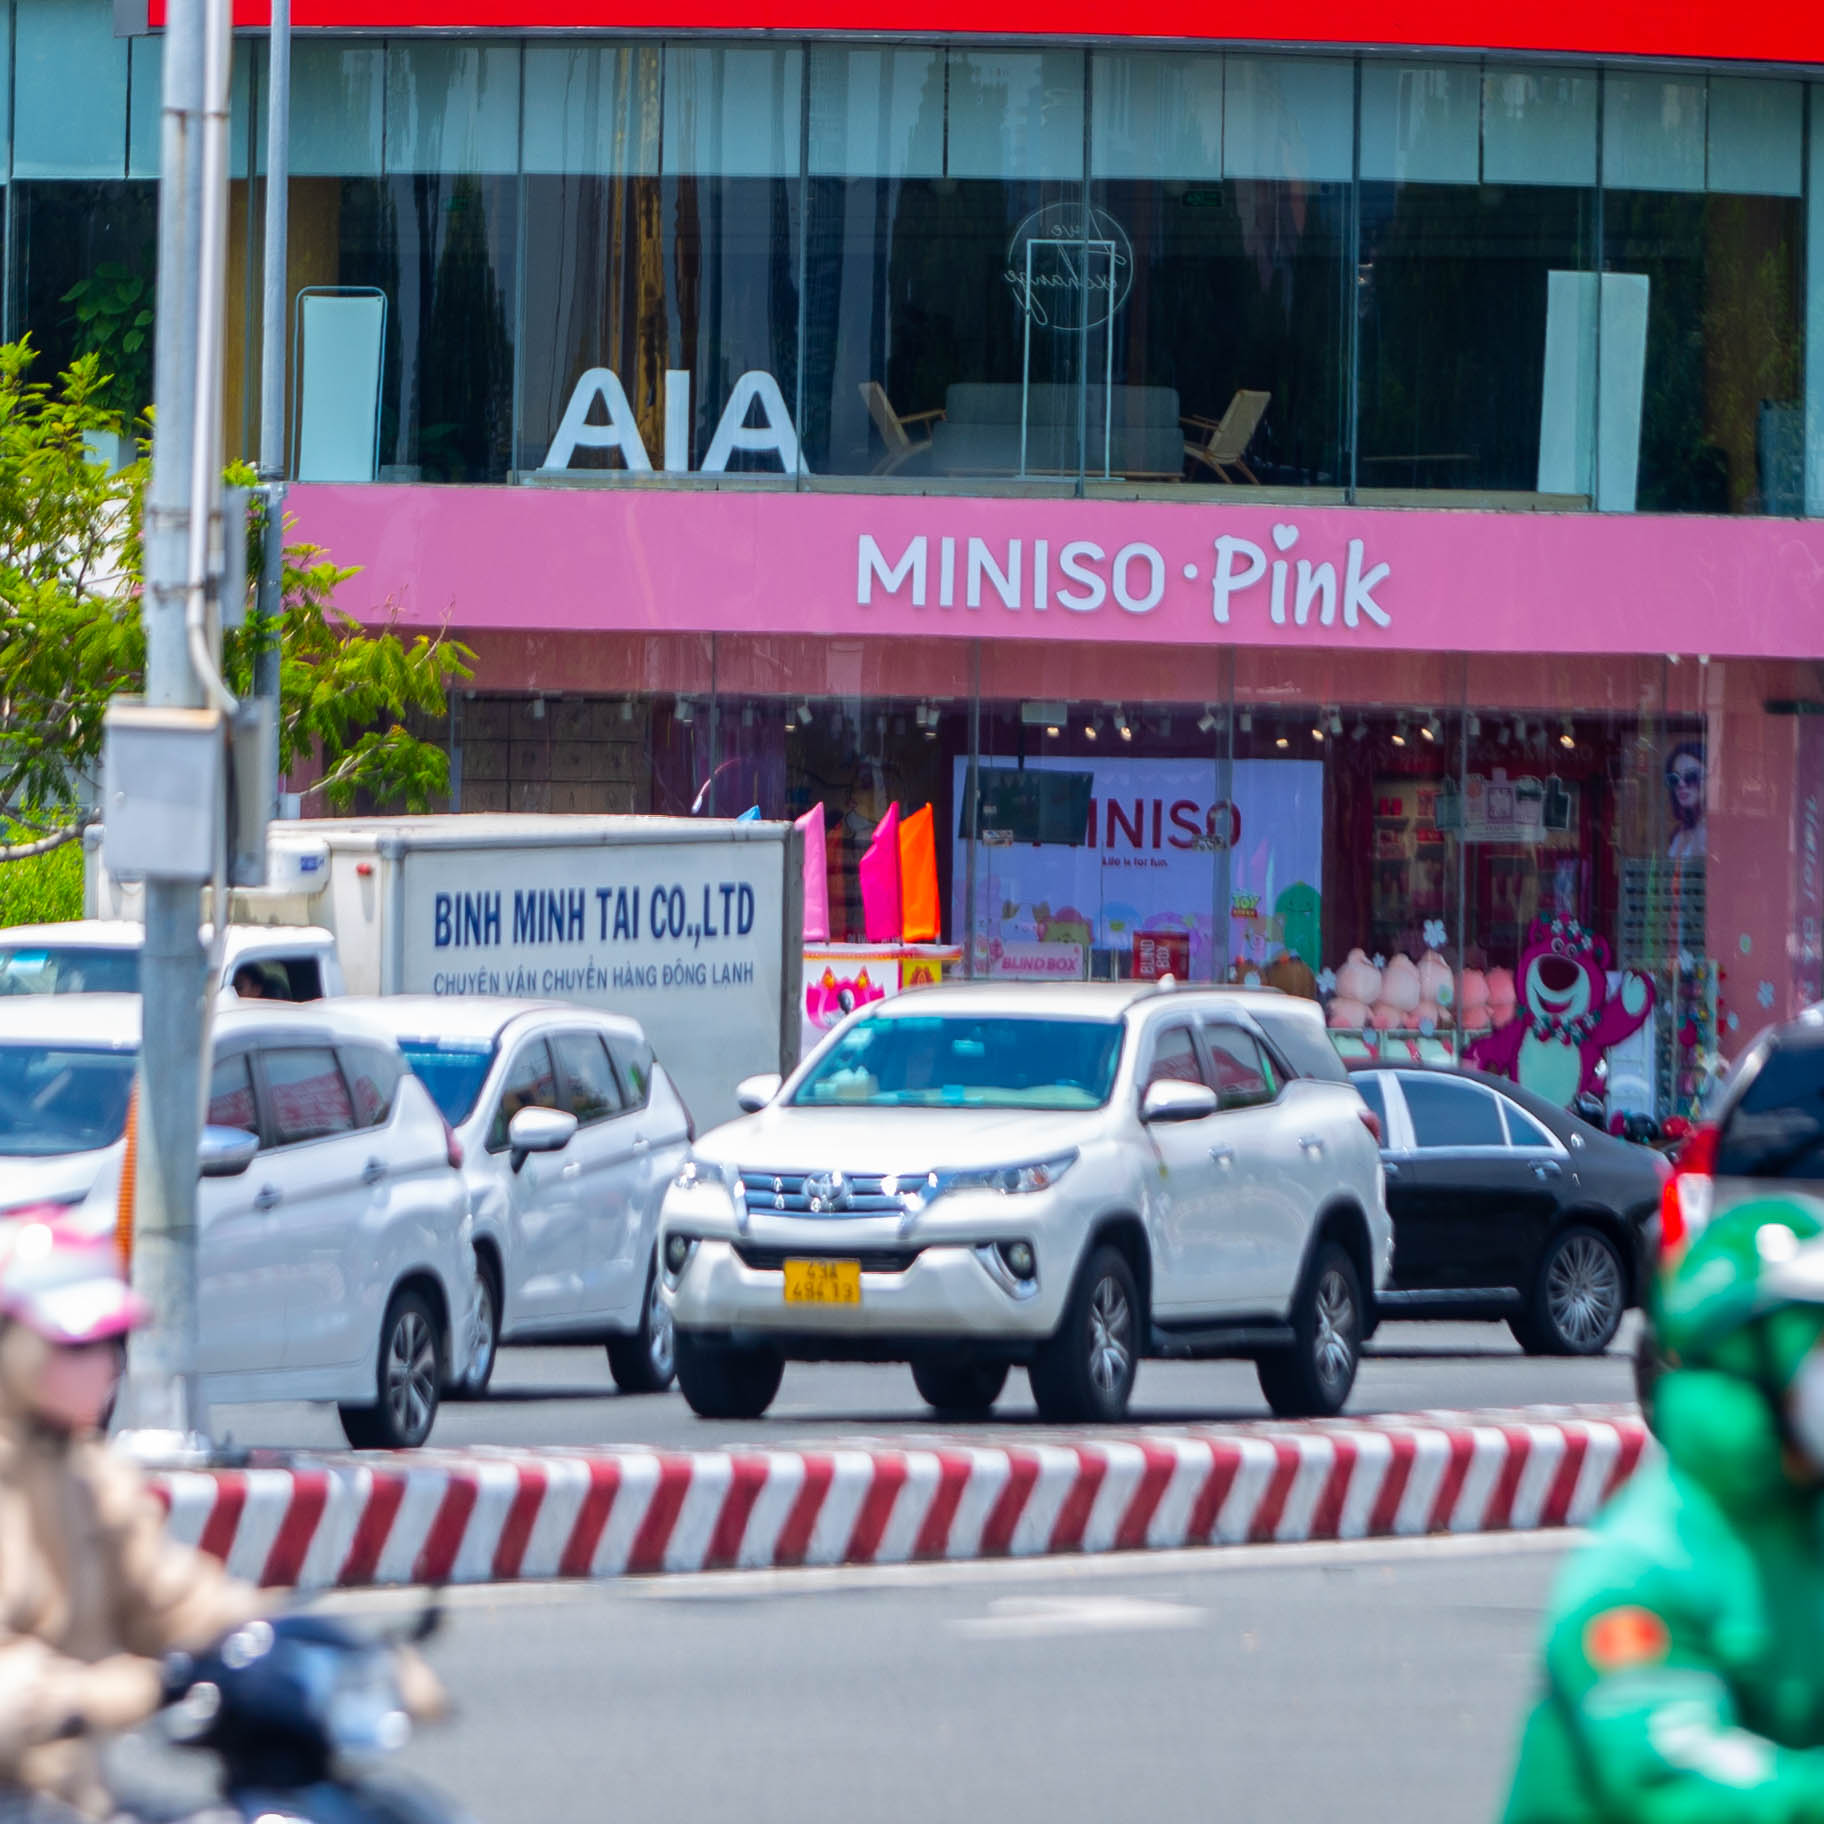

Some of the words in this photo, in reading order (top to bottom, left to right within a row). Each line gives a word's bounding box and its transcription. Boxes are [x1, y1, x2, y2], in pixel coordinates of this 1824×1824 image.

[541, 367, 812, 474] AIA
[1083, 797, 1242, 850] INISO
[434, 890, 502, 948] BINH
[512, 886, 587, 945] MINH
[595, 884, 641, 942] TAI
[612, 961, 658, 989] HÀNG
[662, 957, 707, 987] ĐÔNG
[1001, 958, 1046, 972] BLIND
